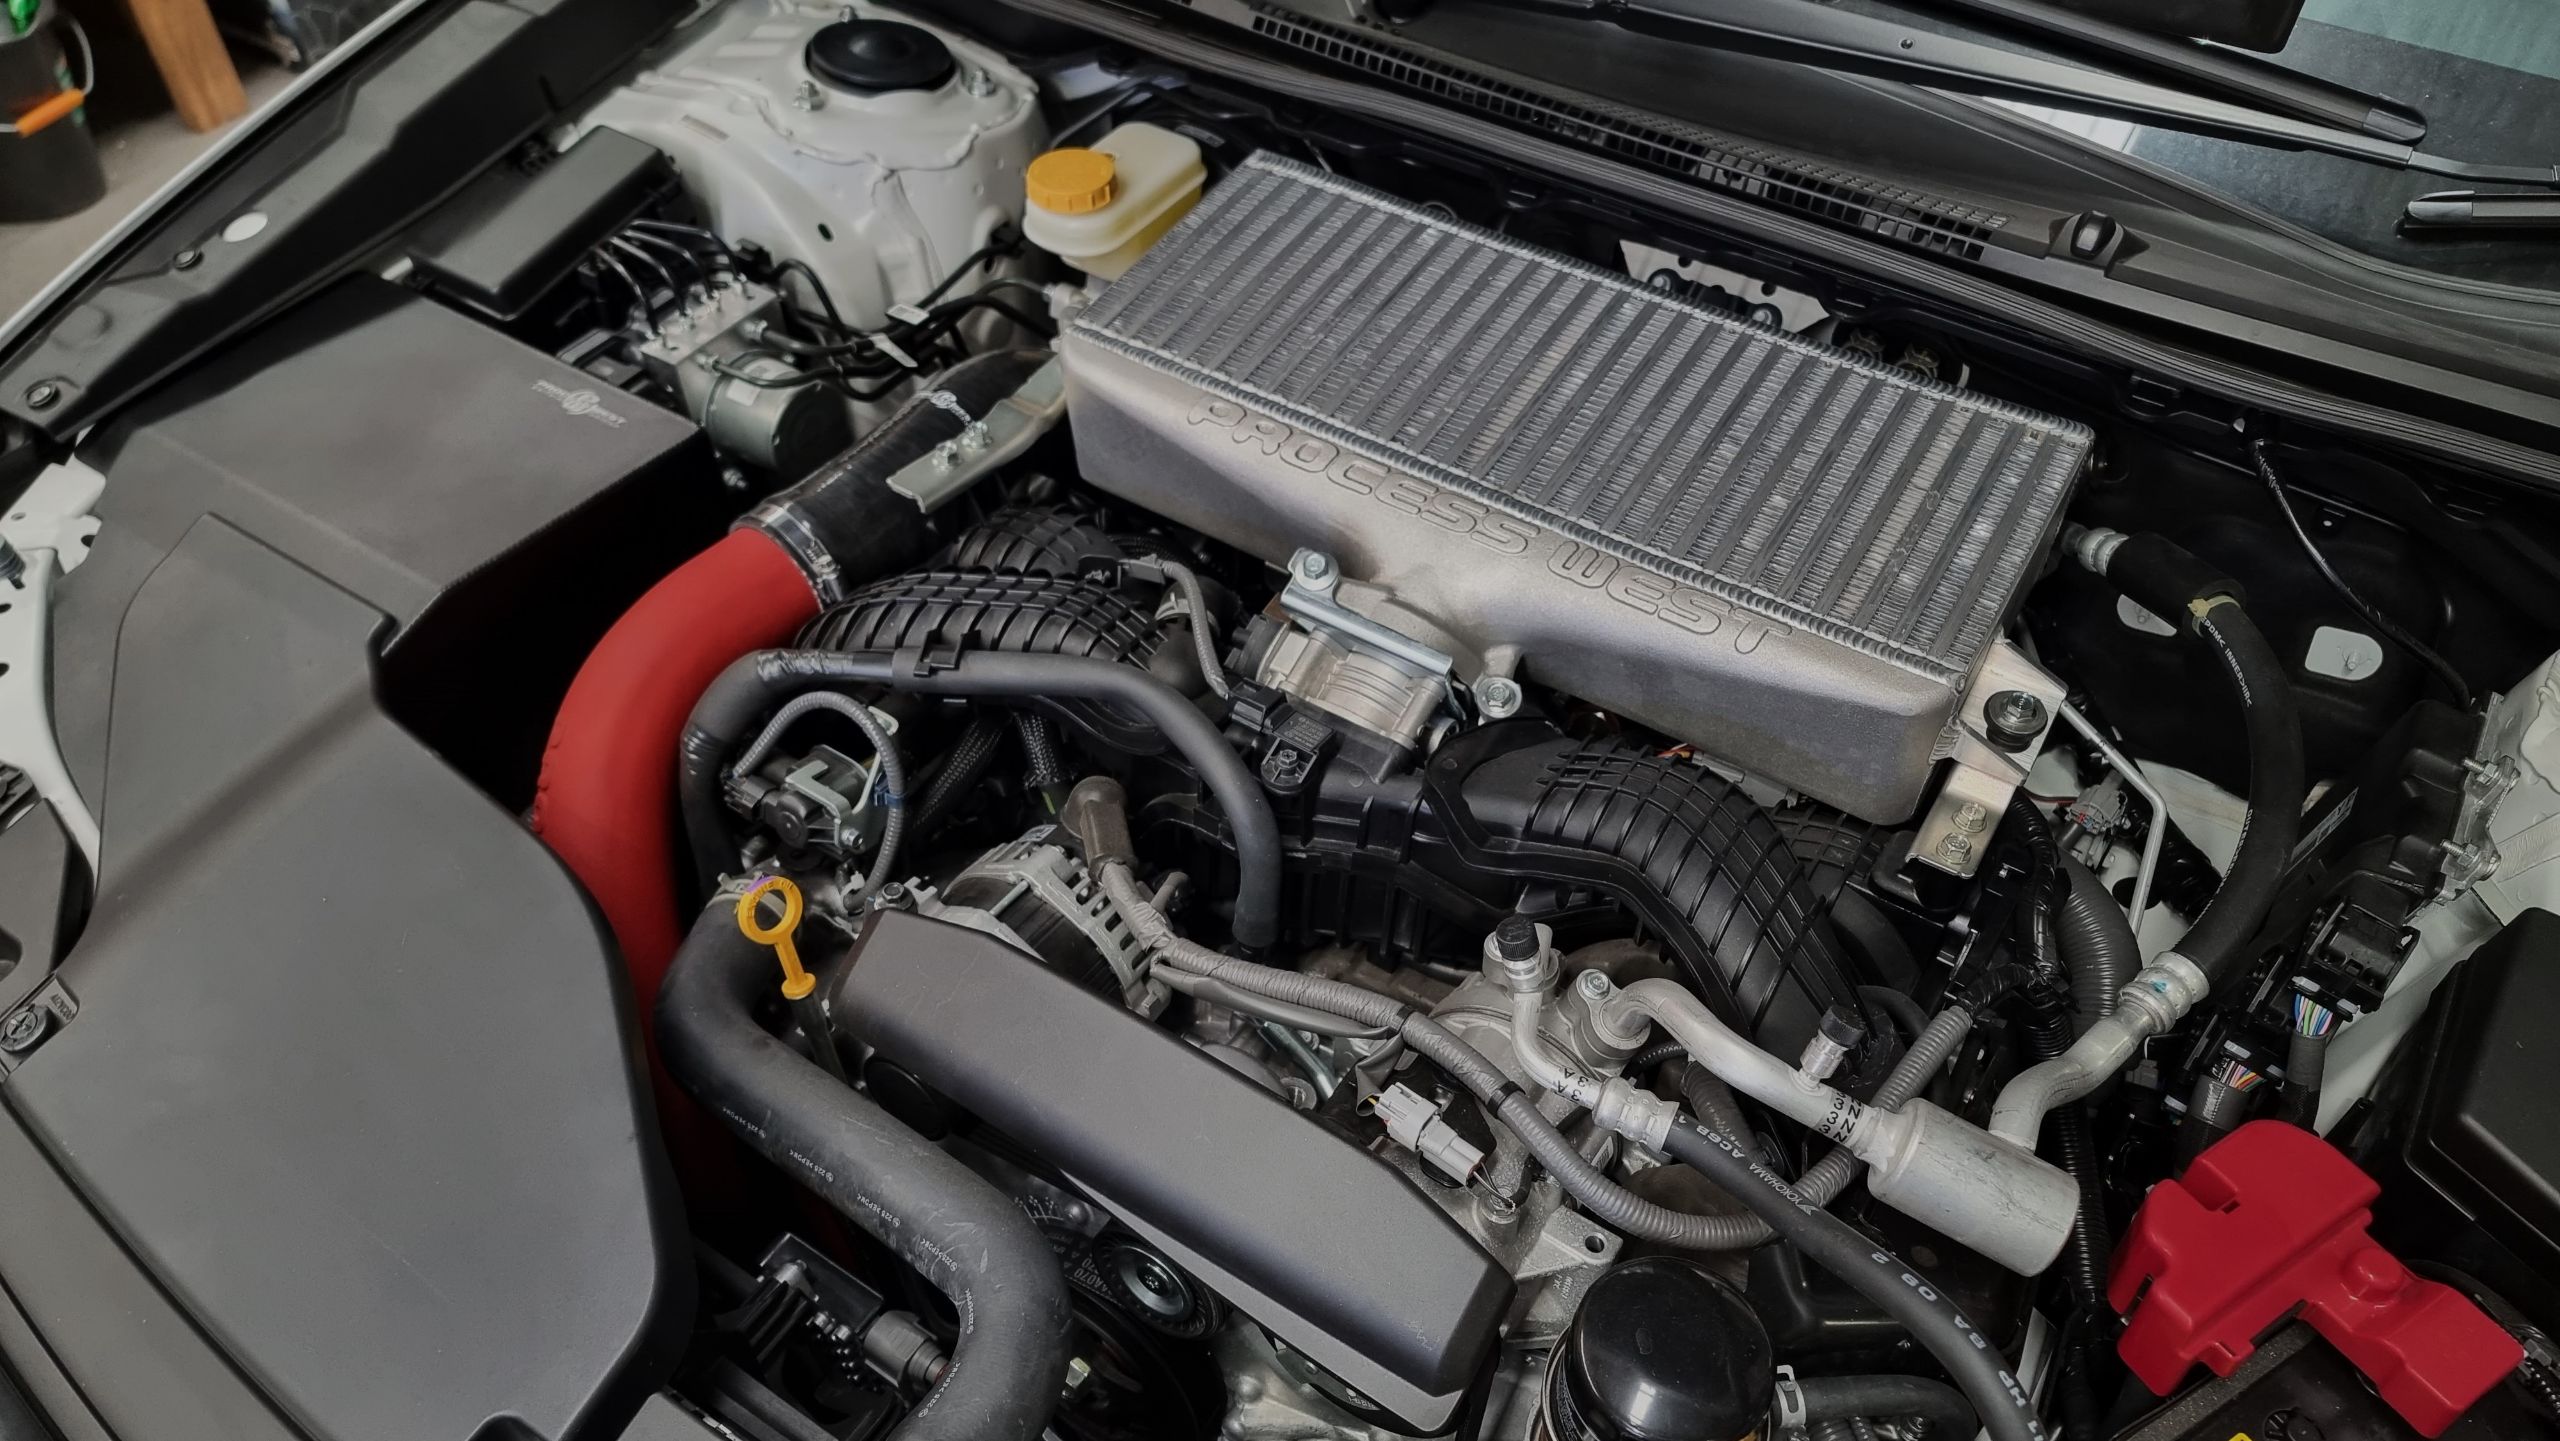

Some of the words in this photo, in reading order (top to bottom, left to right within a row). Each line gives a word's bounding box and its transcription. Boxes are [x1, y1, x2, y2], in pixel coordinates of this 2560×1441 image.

[1186, 397, 1541, 555] PROCESS
[1546, 540, 1793, 654] WEST
[1695, 1124, 1746, 1159] AC6B
[1749, 1162, 1804, 1207] YOKOHAMA
[1870, 1251, 1890, 1265] 2
[1901, 1272, 1938, 1302] 09
[1998, 1369, 2027, 1408] HP
